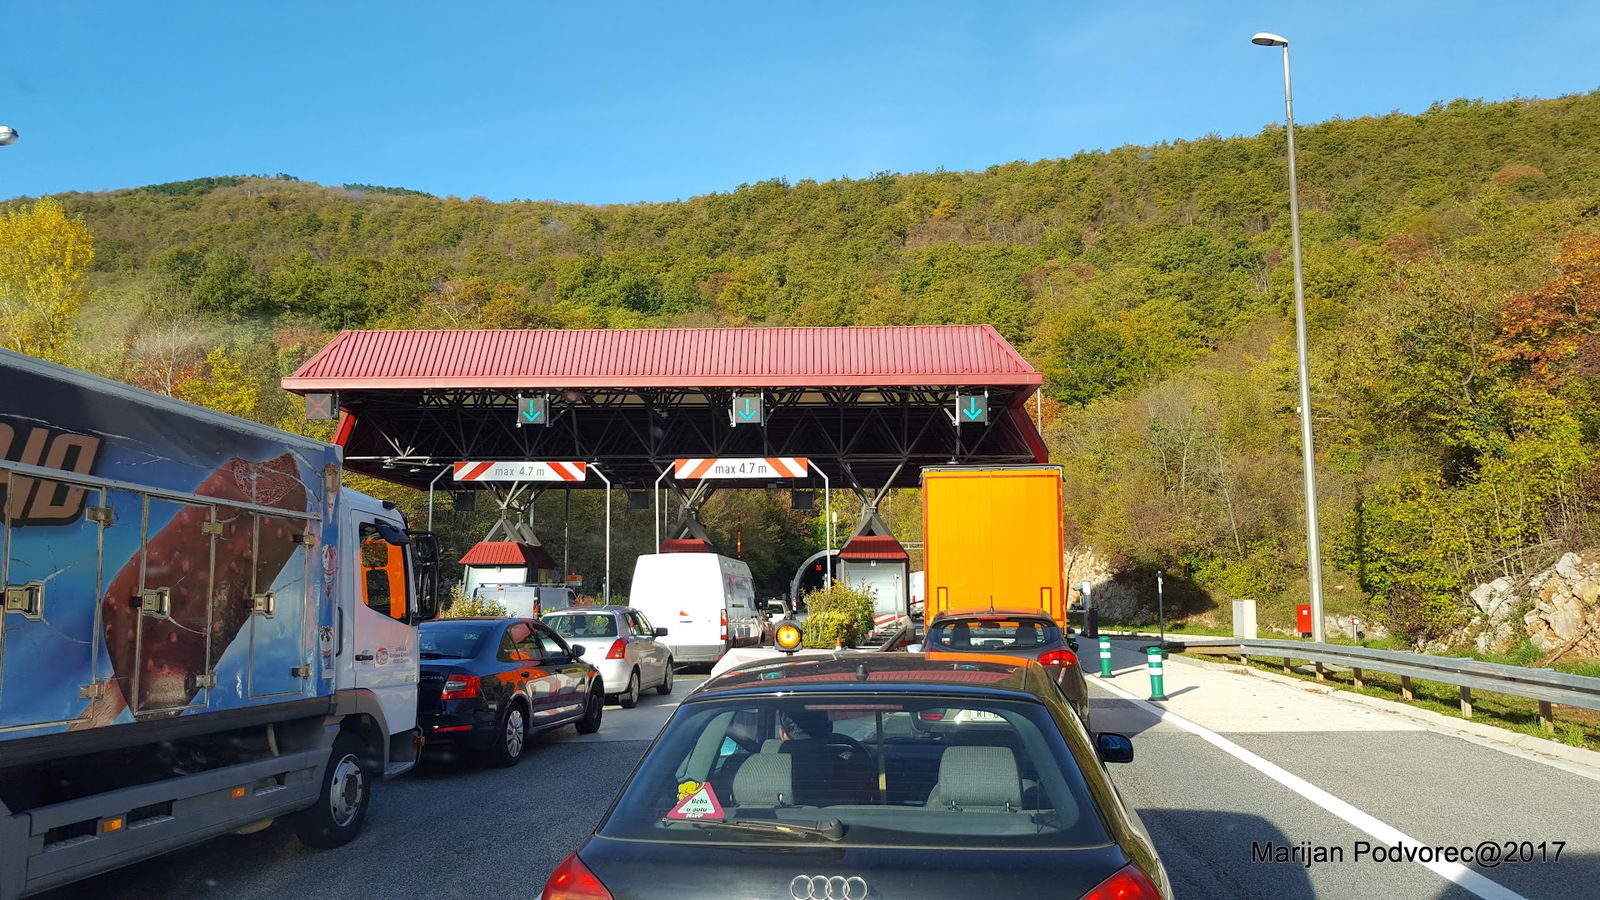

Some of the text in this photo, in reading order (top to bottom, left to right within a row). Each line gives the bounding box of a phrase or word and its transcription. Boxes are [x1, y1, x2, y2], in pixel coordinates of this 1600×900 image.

[495, 466, 545, 477] max 4.7 m
[715, 462, 767, 474] max 4.7 m
